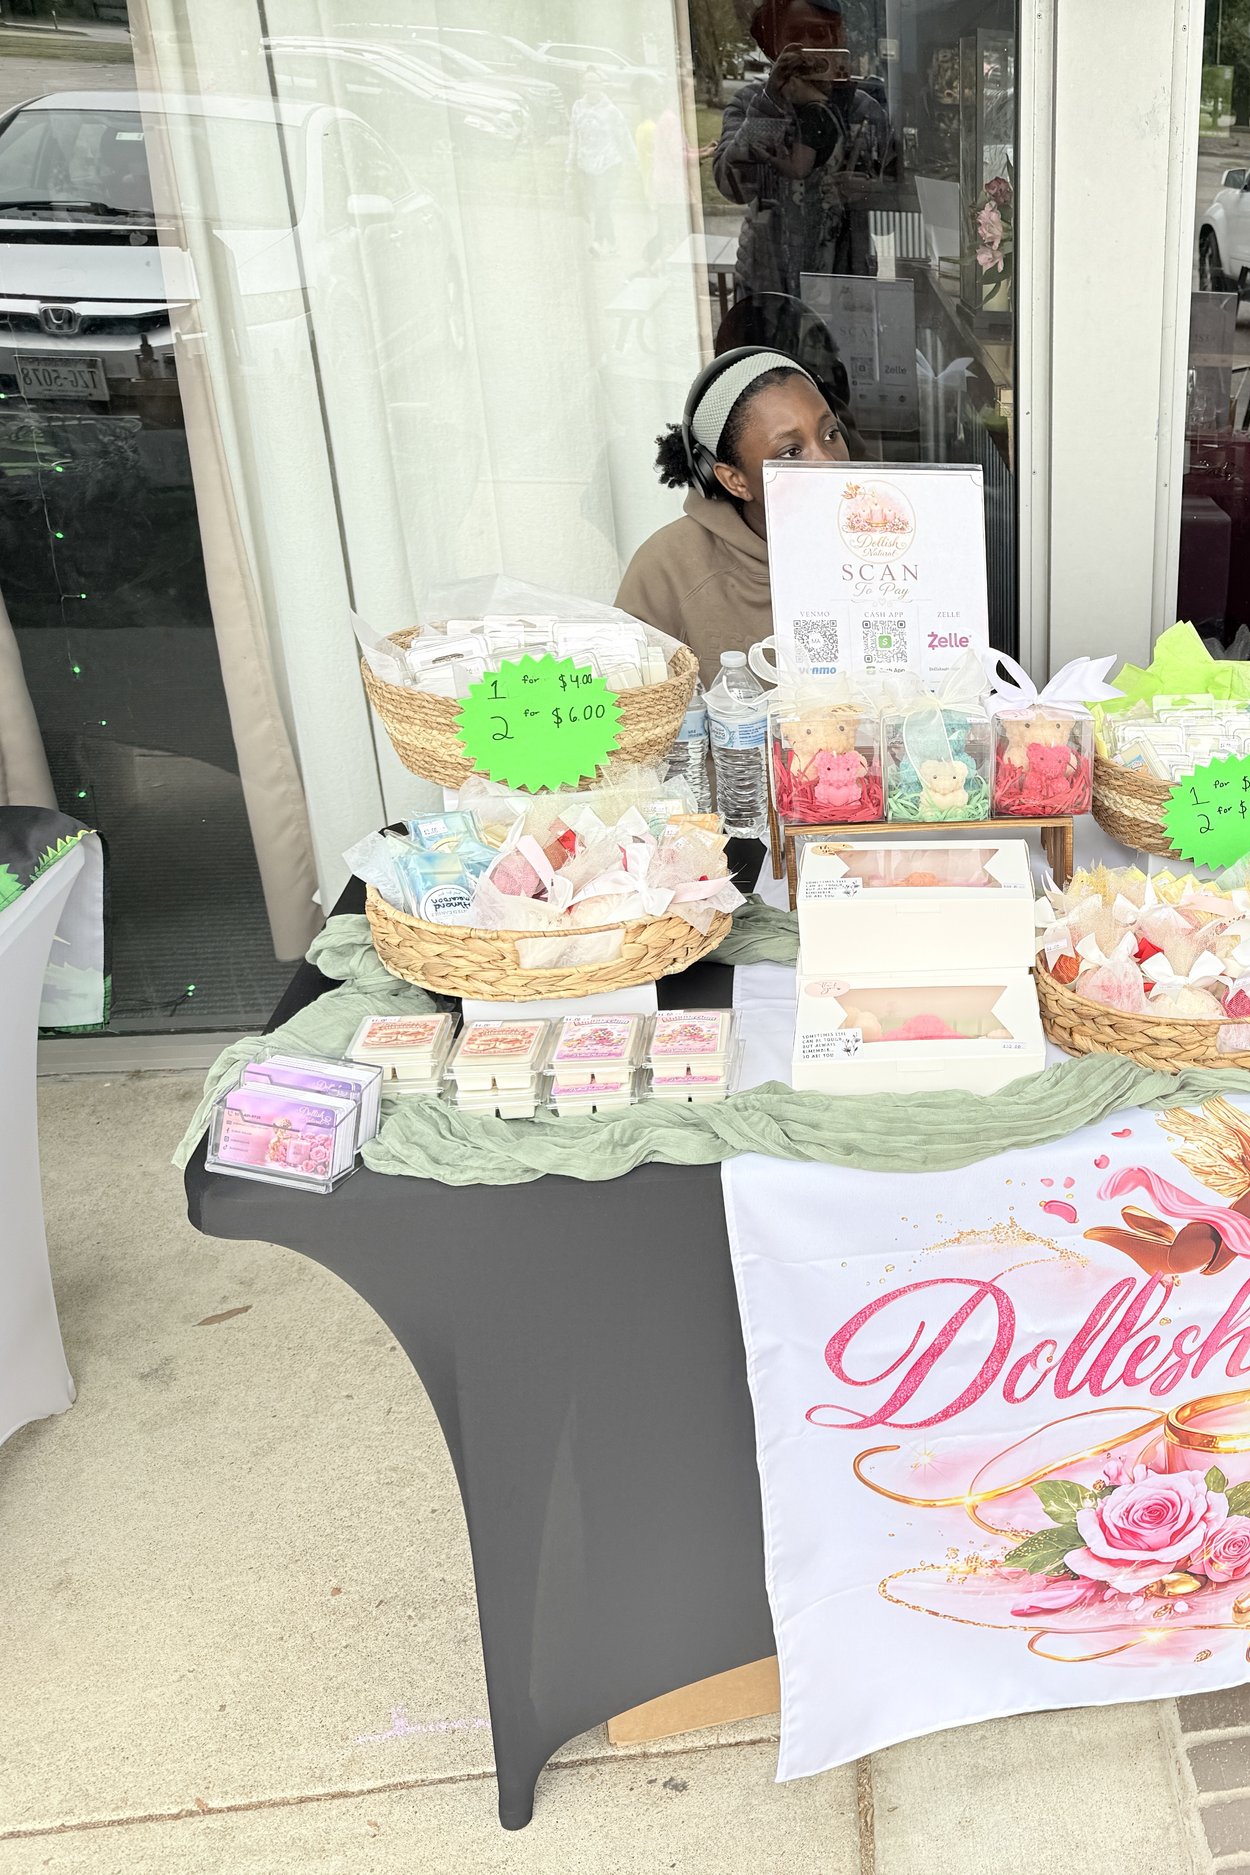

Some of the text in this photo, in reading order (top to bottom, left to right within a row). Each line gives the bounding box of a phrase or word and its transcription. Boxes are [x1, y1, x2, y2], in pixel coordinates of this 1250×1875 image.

[842, 563, 920, 582] SCAN
[854, 582, 910, 600] To Pay
[800, 610, 830, 618] VENMO
[927, 631, 969, 650] Zelle
[488, 673, 593, 700] 1 for $4.00
[490, 704, 606, 741] 2 for $6.00
[1189, 786, 1210, 806] 1
[1197, 813, 1215, 834] 2
[1216, 806, 1233, 815] for
